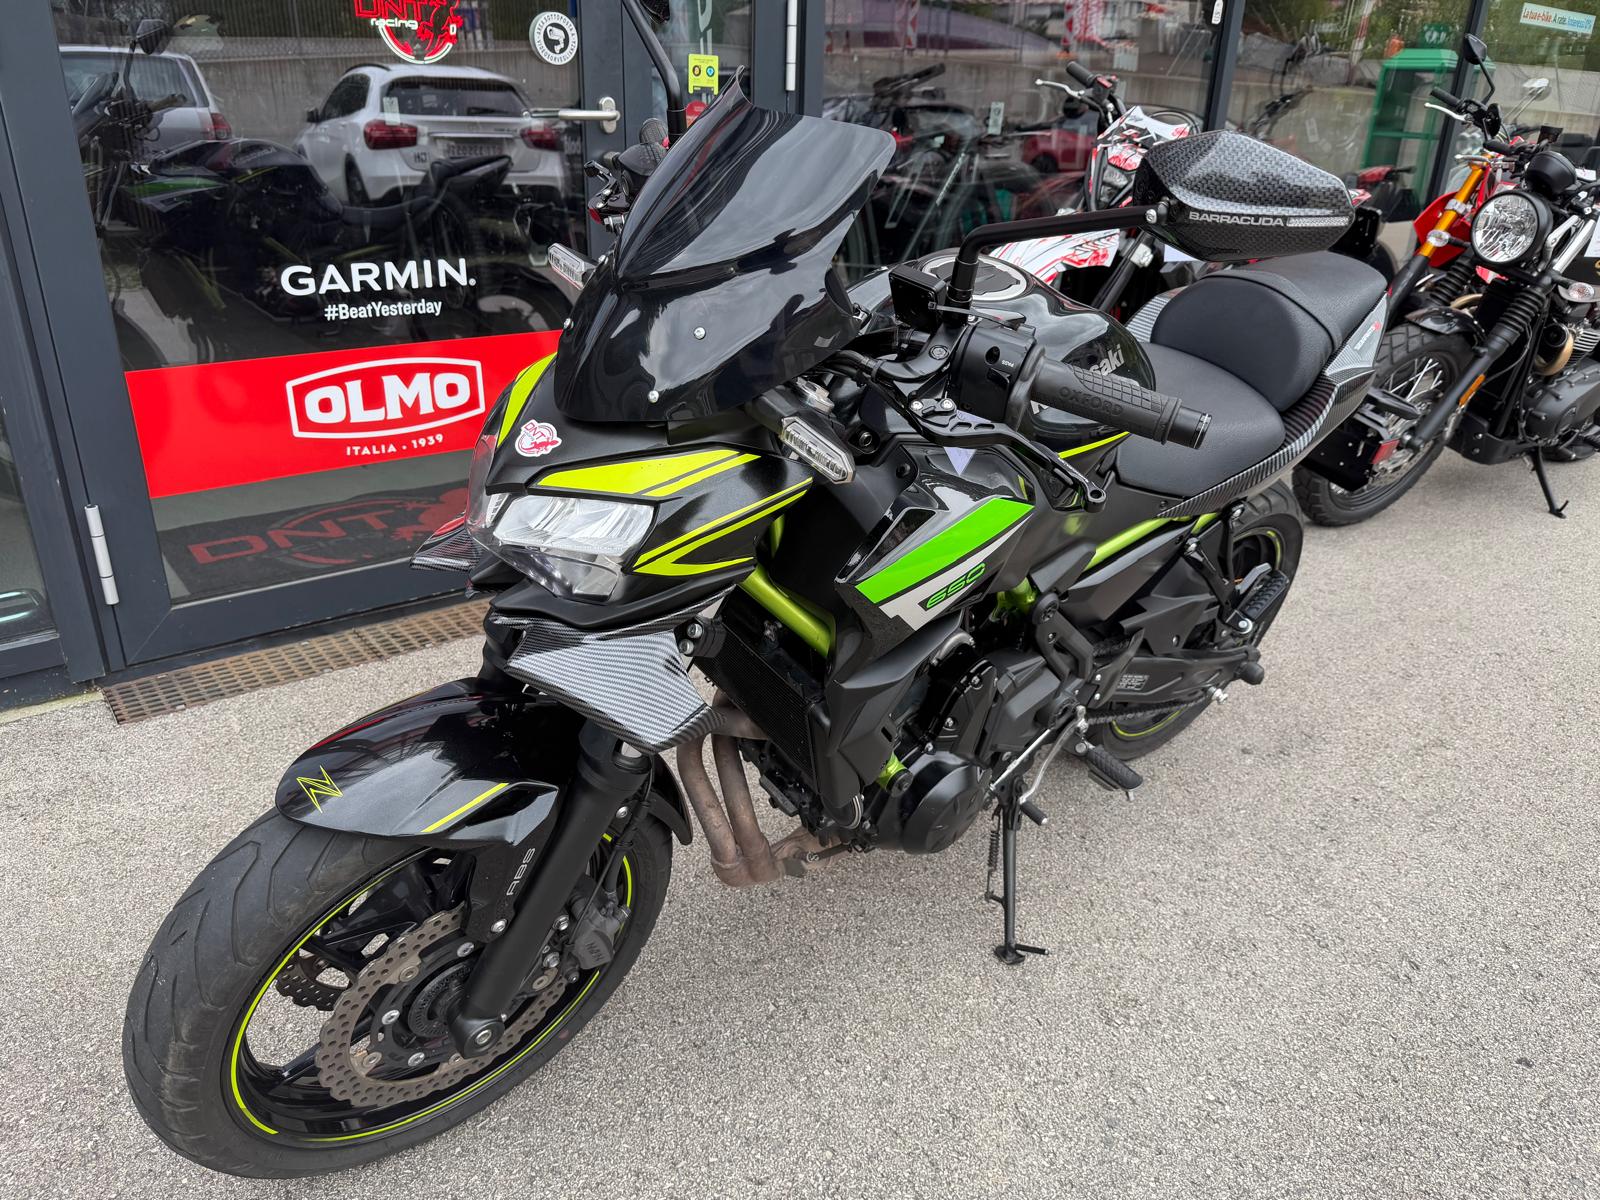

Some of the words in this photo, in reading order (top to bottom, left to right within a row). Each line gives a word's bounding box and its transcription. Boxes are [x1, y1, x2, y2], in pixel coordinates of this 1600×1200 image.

[370, 18, 418, 30] racing
[1188, 211, 1284, 227] BARRACUDA
[324, 299, 442, 321] #BeatYesterday
[304, 372, 471, 424] OLMO
[1059, 386, 1124, 416] OXFORD
[524, 422, 546, 440] DNT
[346, 445, 397, 456] ITALIA
[412, 434, 444, 449] 1939
[188, 509, 395, 564] DNT
[926, 562, 986, 609] 650
[506, 847, 535, 896] ABS
